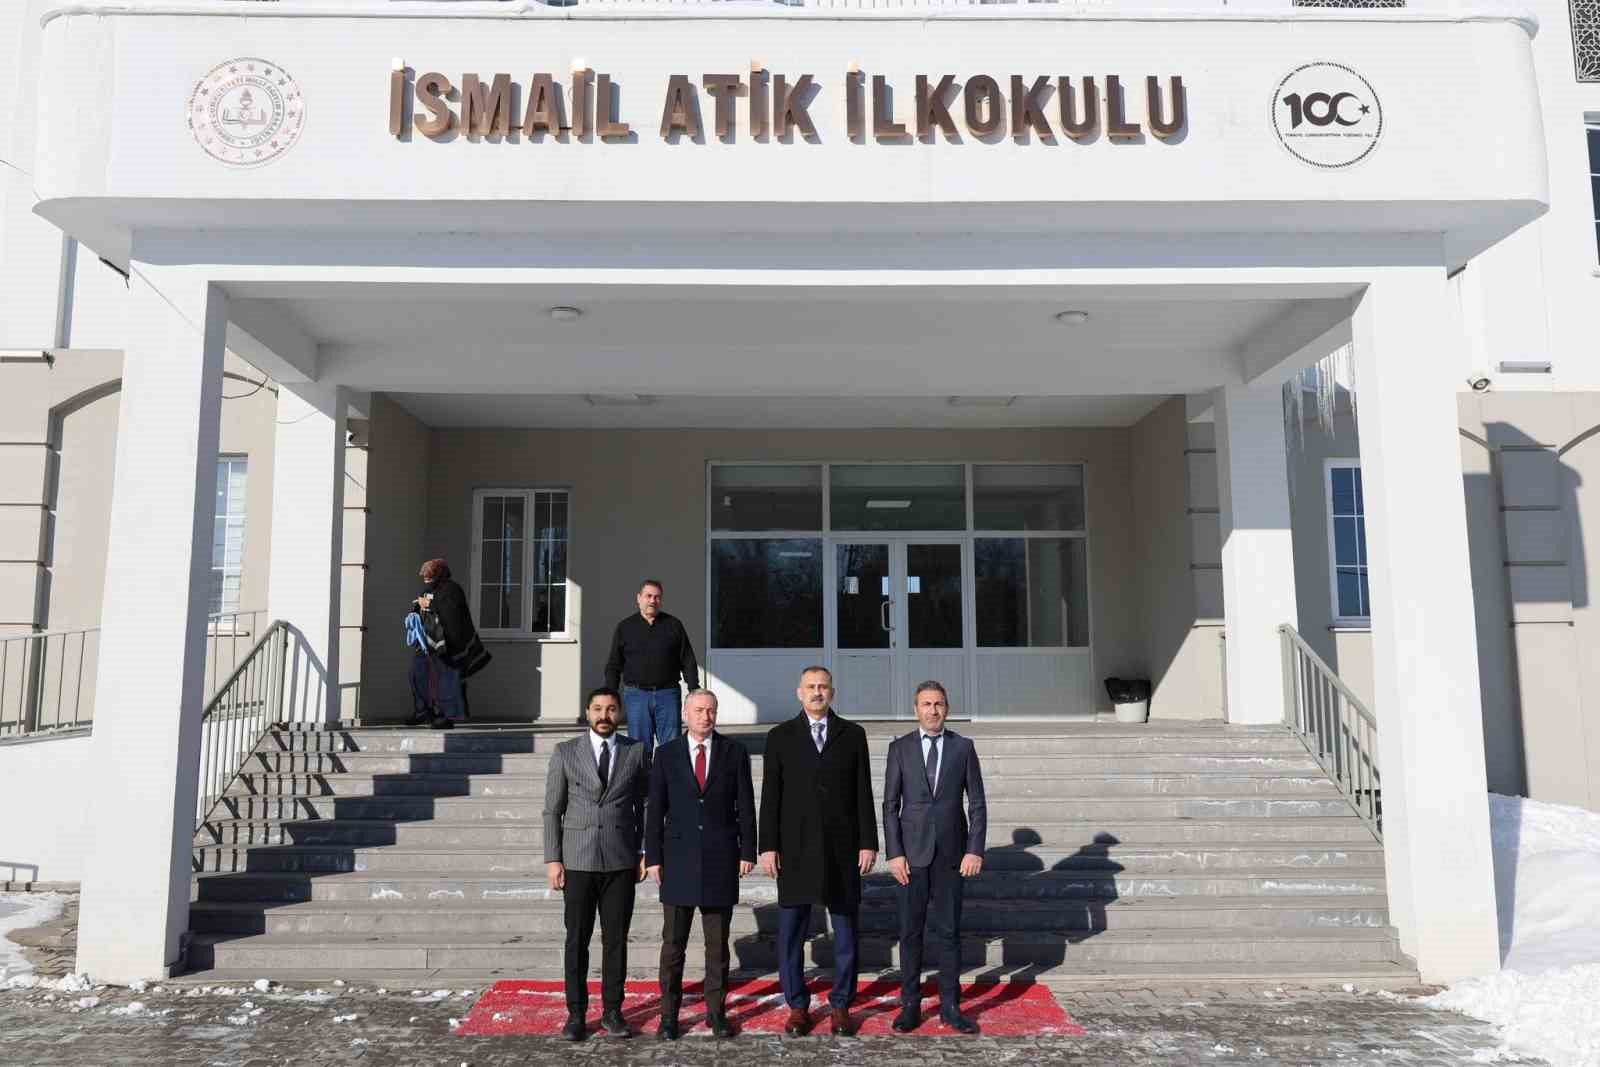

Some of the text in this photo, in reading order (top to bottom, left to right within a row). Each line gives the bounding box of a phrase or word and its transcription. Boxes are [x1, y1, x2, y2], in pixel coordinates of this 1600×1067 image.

[389, 57, 1186, 140] İSMAİL ATİK İLKOKULU
